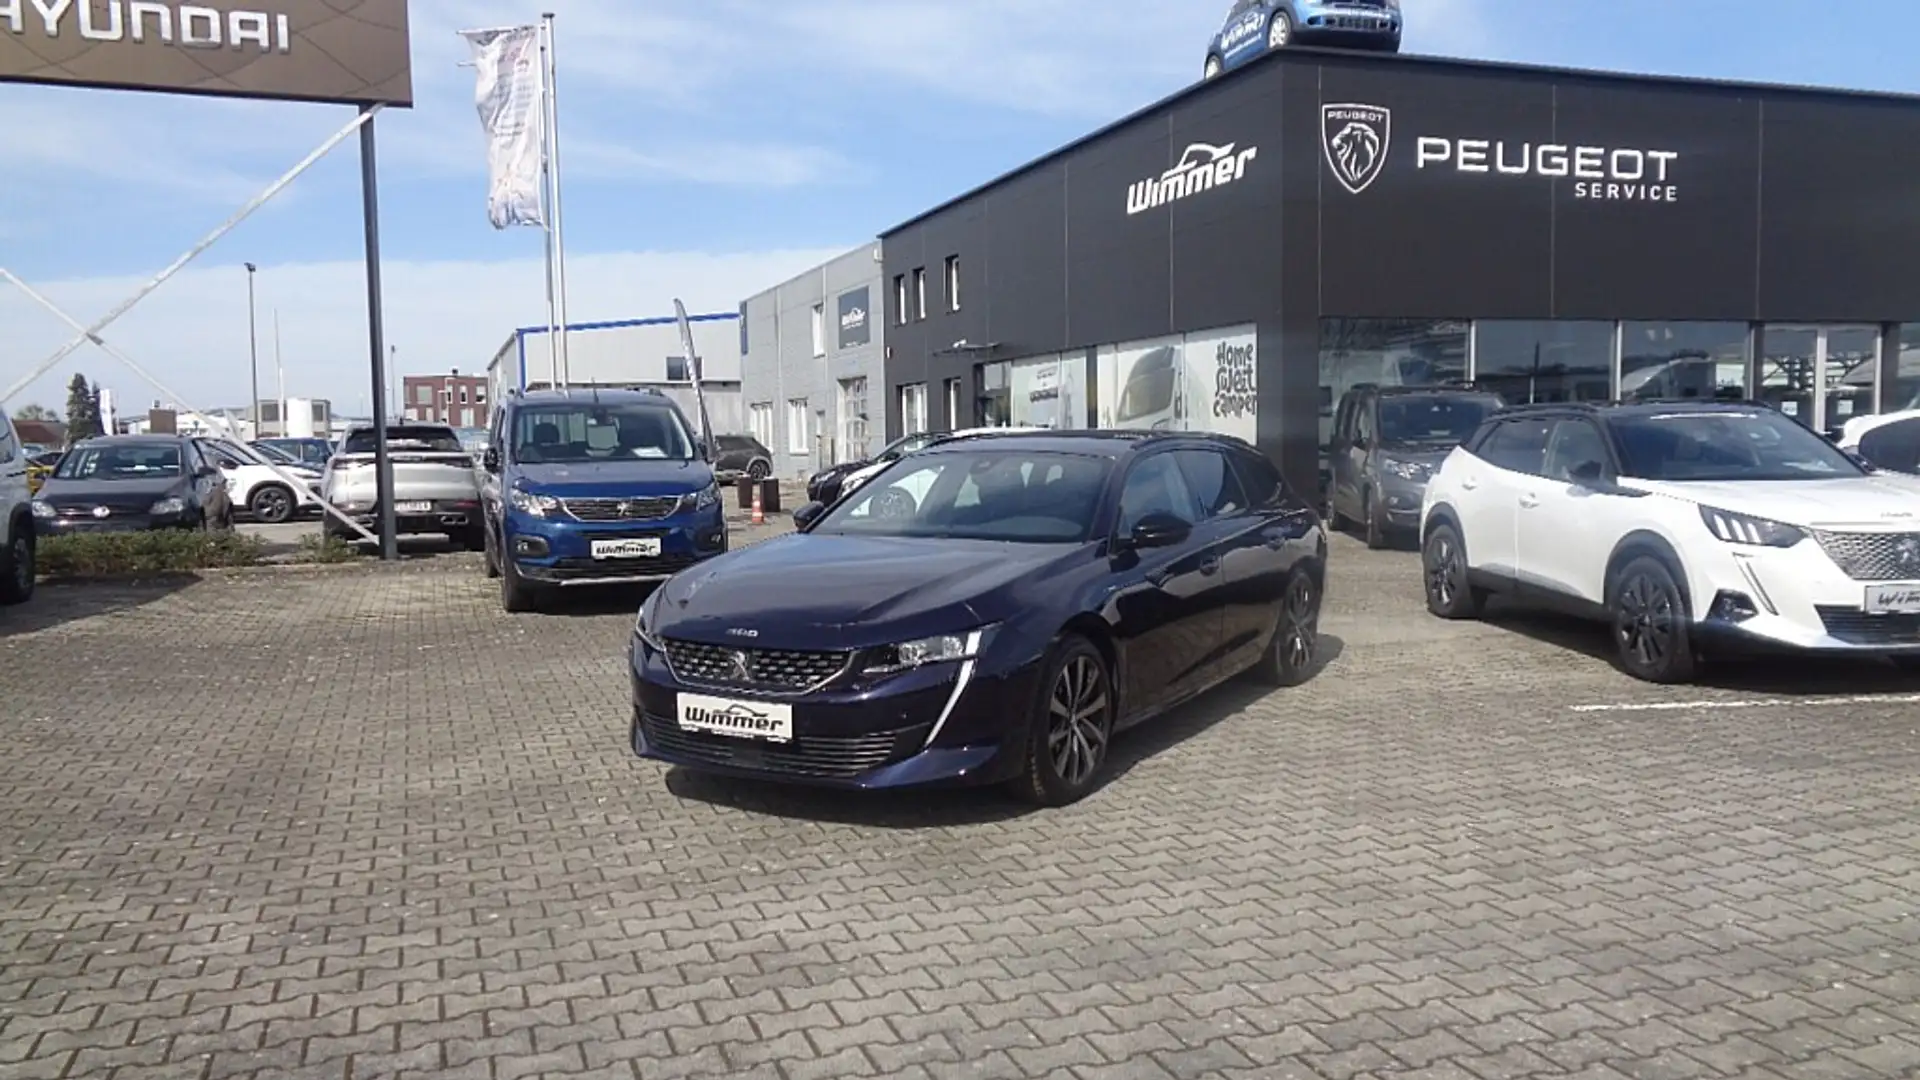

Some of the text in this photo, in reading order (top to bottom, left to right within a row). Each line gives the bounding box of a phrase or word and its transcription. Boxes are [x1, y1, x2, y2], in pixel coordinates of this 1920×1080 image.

[1327, 110, 1384, 122] PEUGEOT
[1417, 136, 1679, 182] PEUGEOT
[1127, 146, 1258, 215] Wimmer
[1574, 182, 1678, 202] SERVICE
[685, 706, 784, 730] Wimmer
